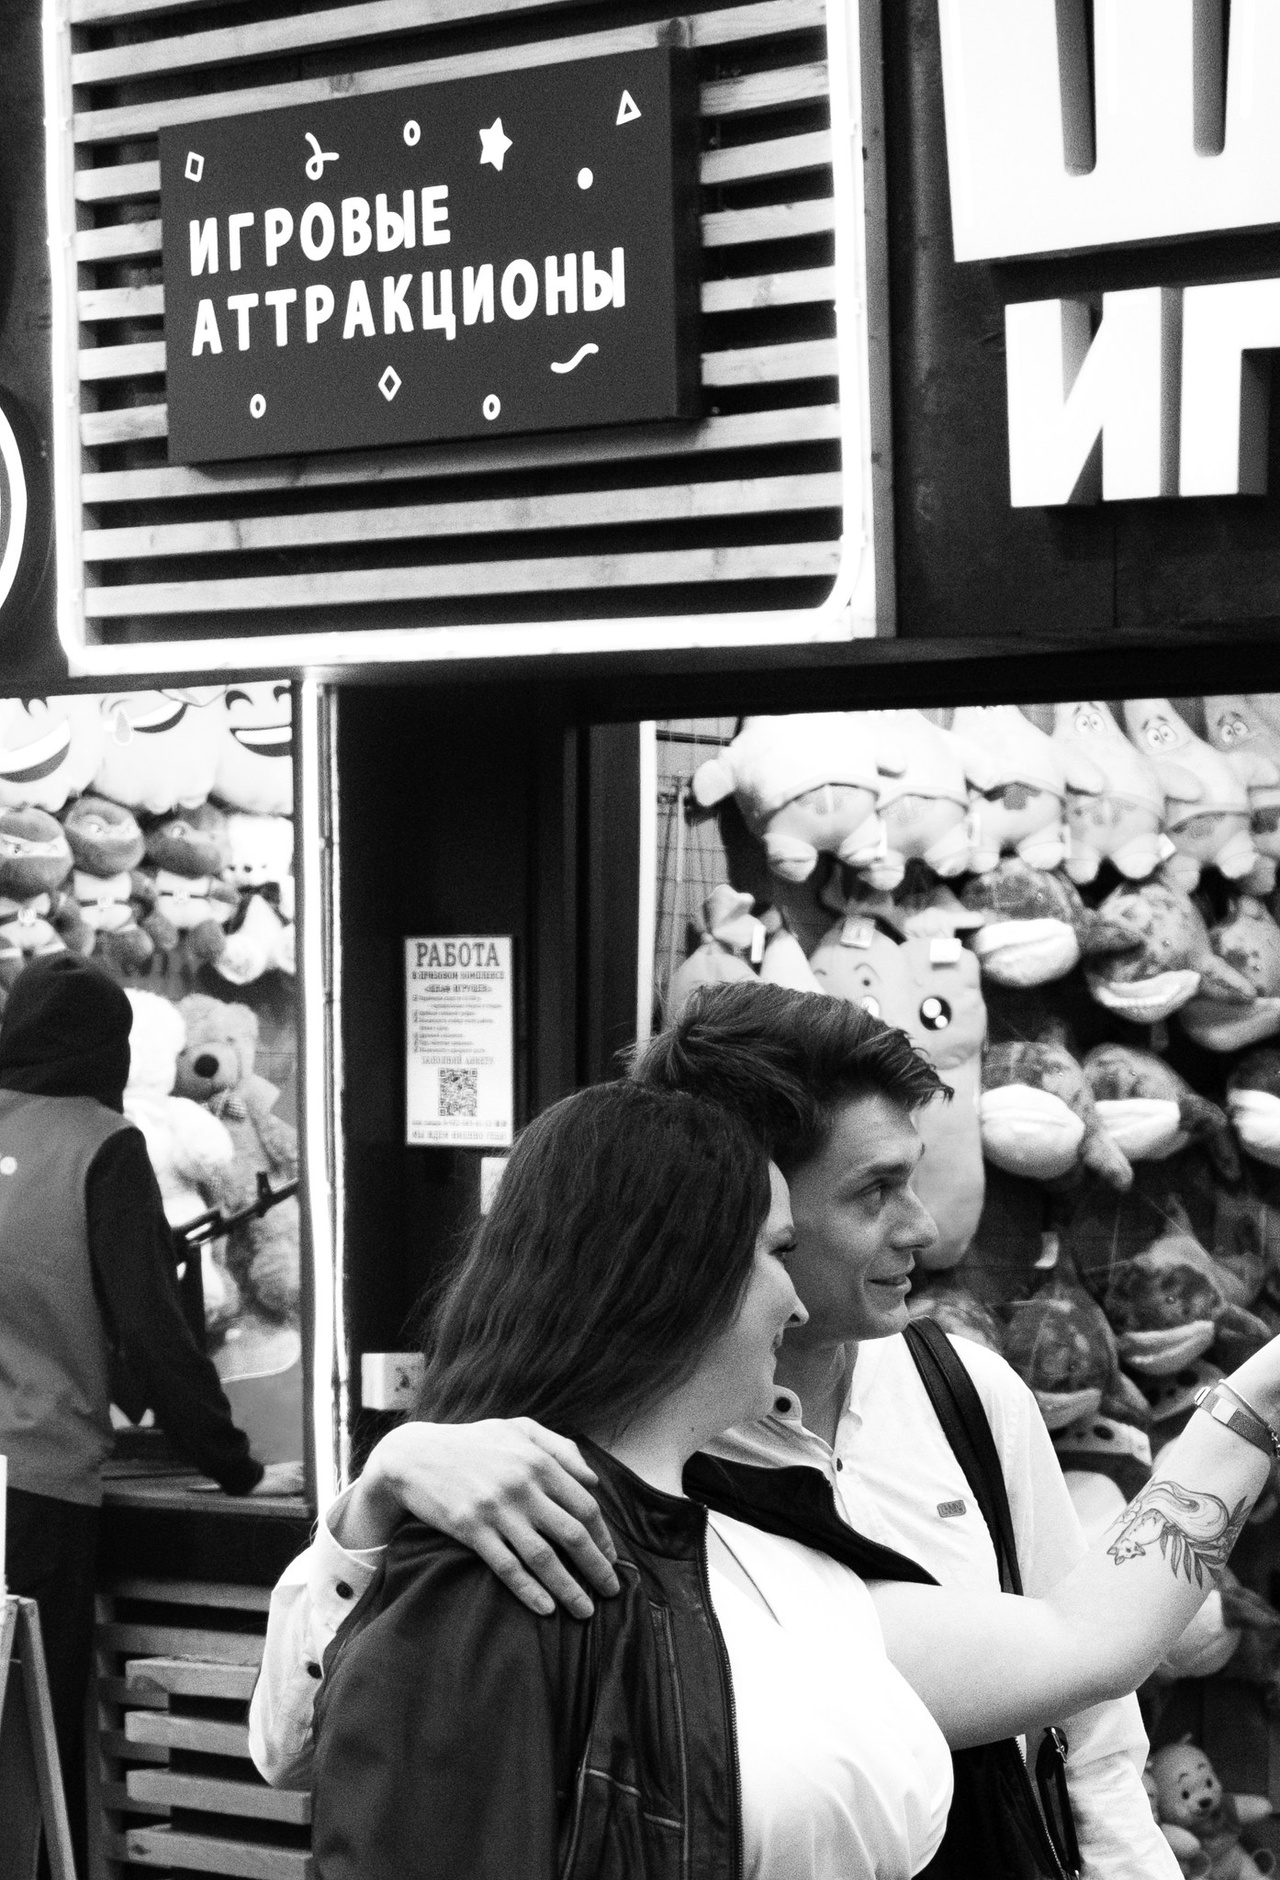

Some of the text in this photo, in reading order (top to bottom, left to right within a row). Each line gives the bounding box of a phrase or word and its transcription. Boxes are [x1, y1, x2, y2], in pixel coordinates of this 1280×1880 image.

[189, 184, 451, 277] ИГРОВЫЕ
[191, 246, 627, 358] АТТРАКЦИОНЫ
[415, 942, 500, 968] РАБОТА
